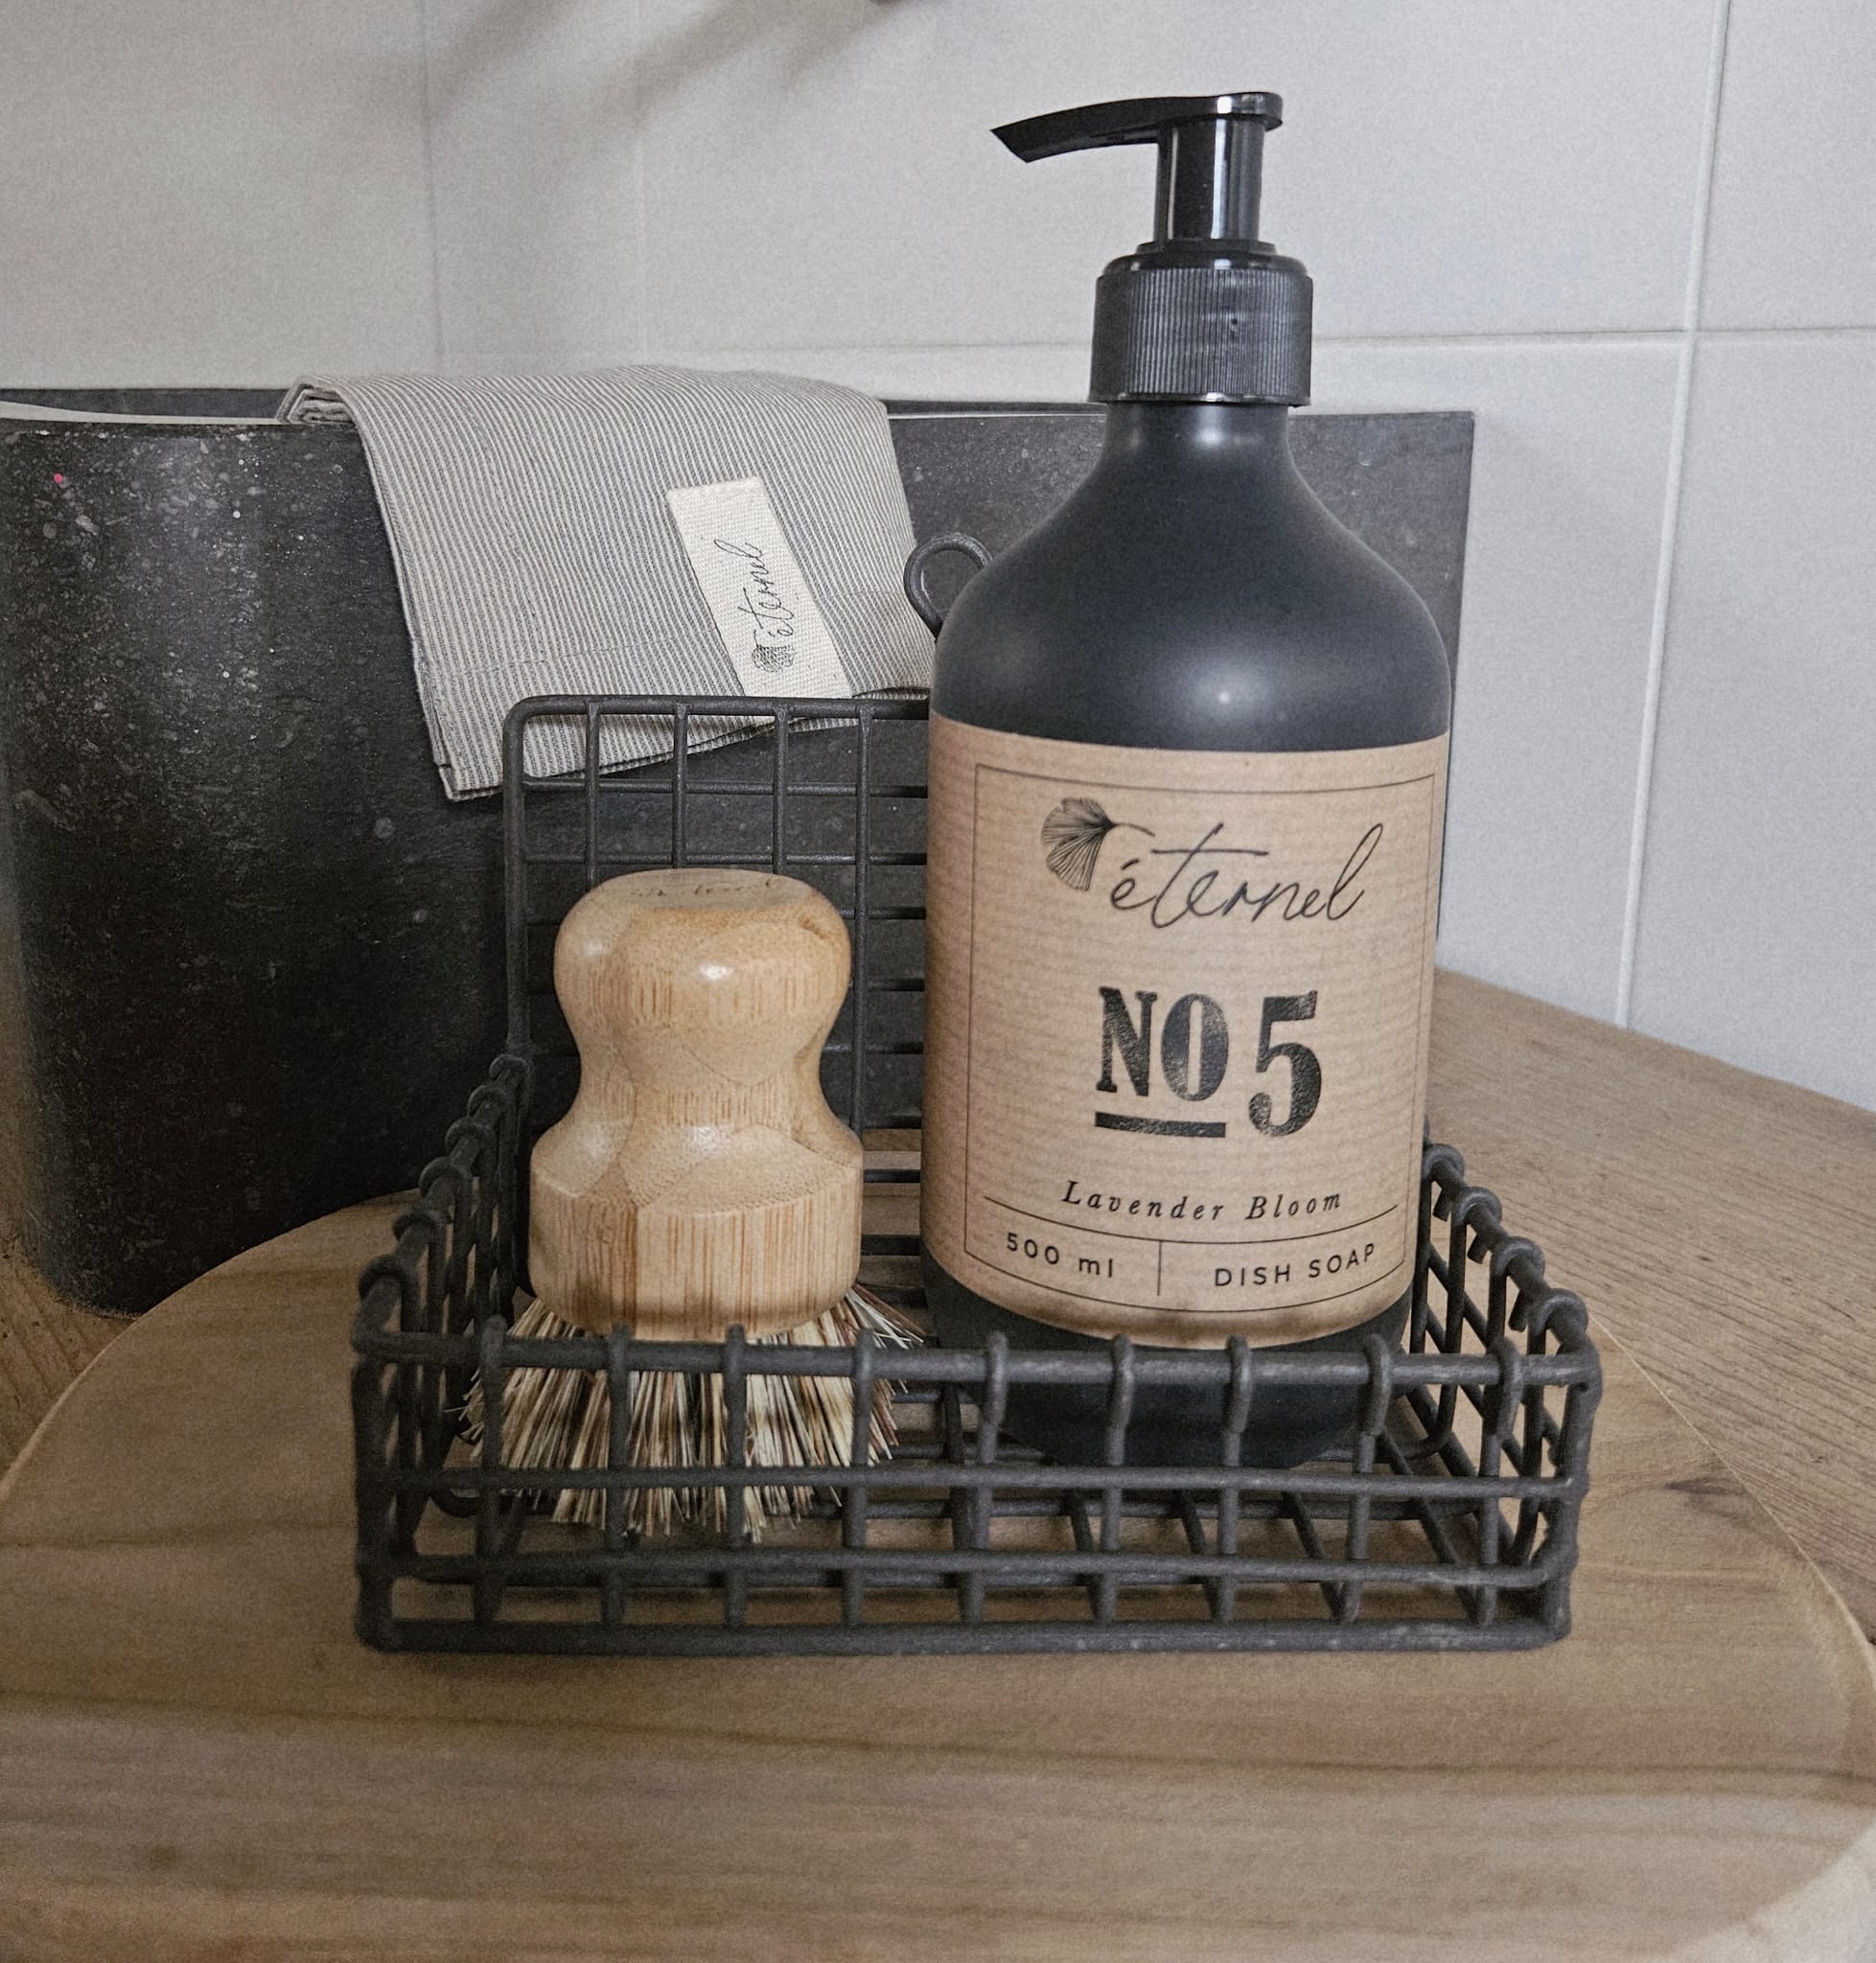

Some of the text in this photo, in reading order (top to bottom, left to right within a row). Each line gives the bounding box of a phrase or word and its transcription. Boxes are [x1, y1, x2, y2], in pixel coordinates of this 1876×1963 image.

[1109, 822, 1384, 929] éternel
[1248, 988, 1322, 1137] 5
[1062, 1180, 1342, 1222] Lavender Bloom
[1006, 1232, 1114, 1279] 500 ml
[1214, 1242, 1376, 1288] DISH SOAP
